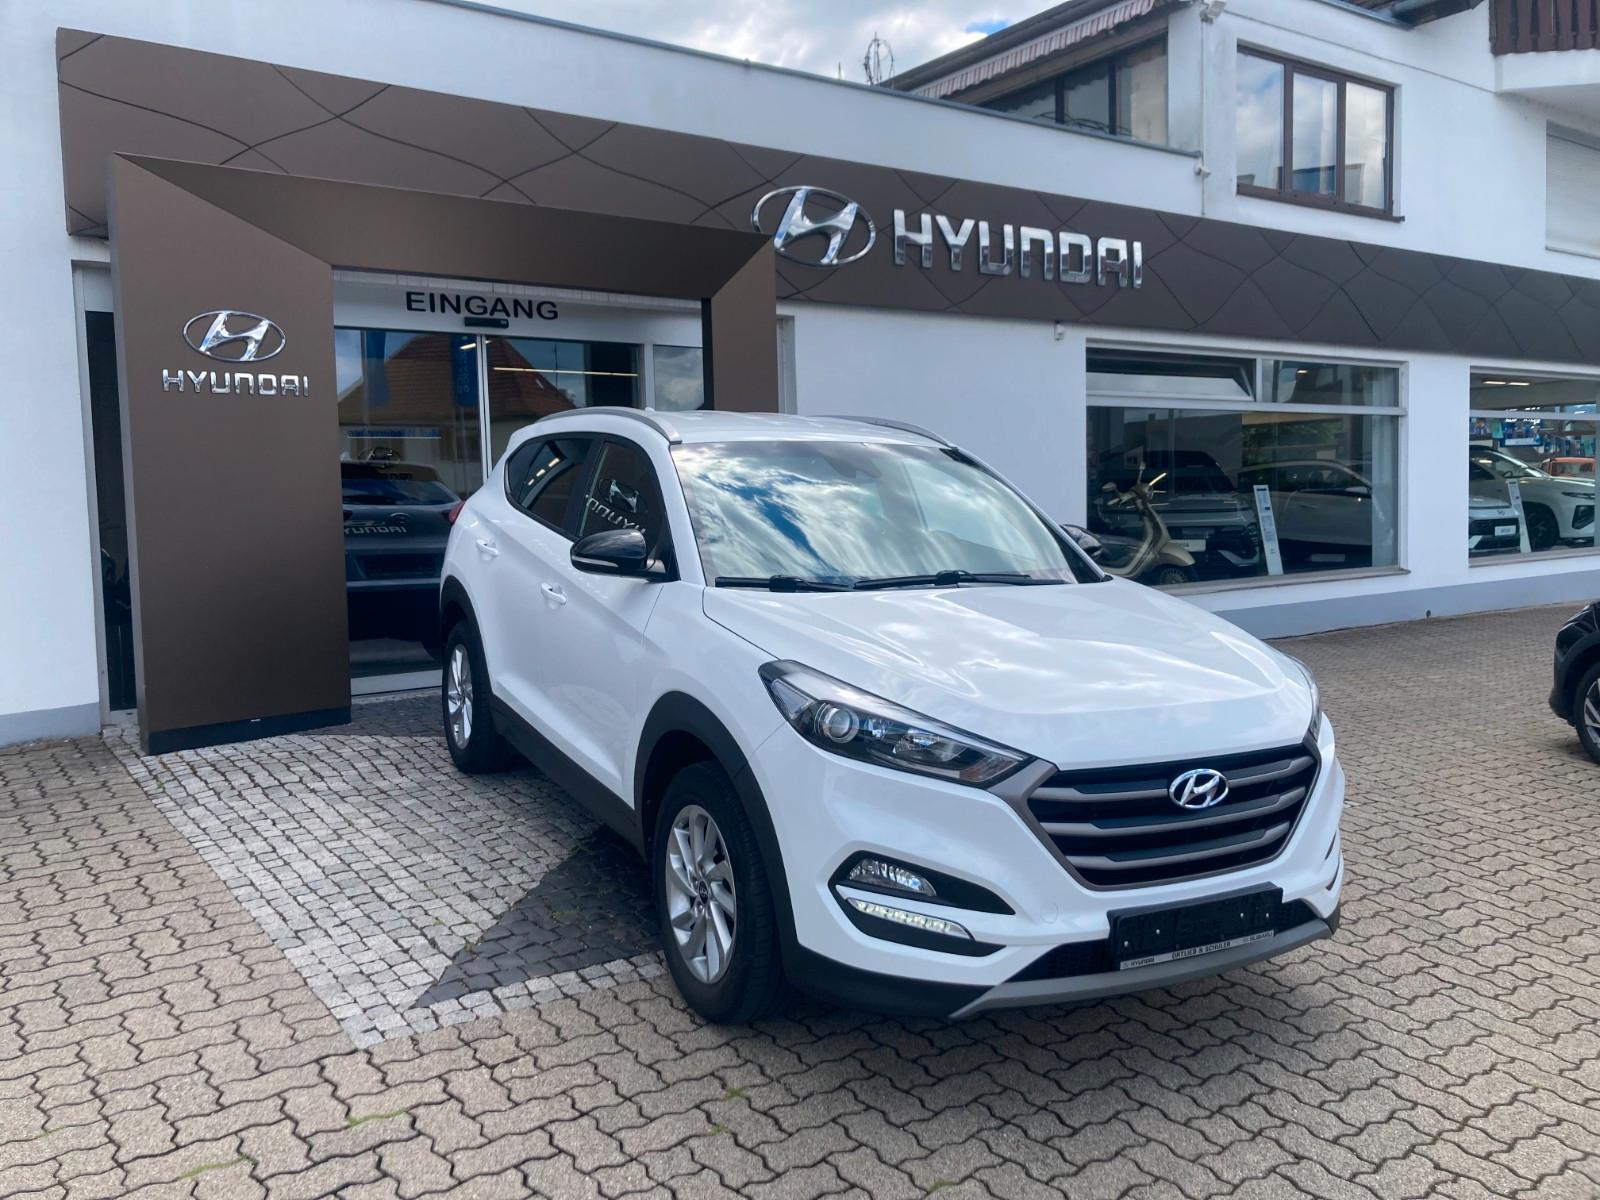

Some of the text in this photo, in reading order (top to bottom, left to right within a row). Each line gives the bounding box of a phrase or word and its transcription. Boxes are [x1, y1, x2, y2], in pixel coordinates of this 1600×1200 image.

[893, 208, 1143, 289] HYUNDAI
[405, 290, 559, 321] EINGANG
[162, 368, 309, 397] HYUNDAI
[343, 525, 408, 535] YUNDAI
